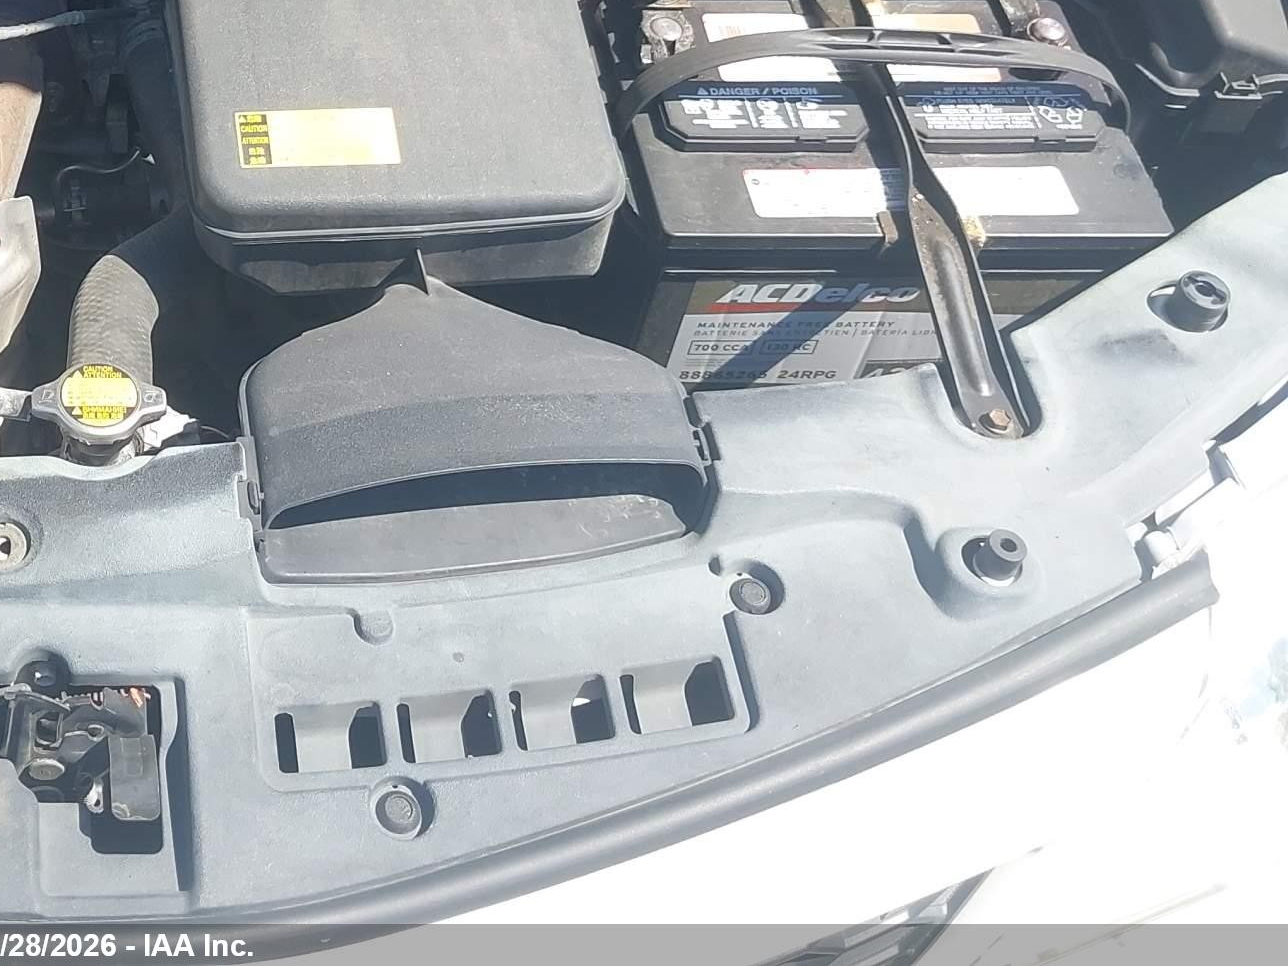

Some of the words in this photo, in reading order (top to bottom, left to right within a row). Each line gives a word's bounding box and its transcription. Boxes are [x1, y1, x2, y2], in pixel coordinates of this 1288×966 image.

[710, 87, 761, 96] DANGER
[715, 283, 922, 303] ACDelco
[697, 321, 792, 329] MAINTENANCE
[835, 321, 896, 329] BATTERY
[694, 344, 719, 352] 700
[777, 370, 837, 380] 24RPG
